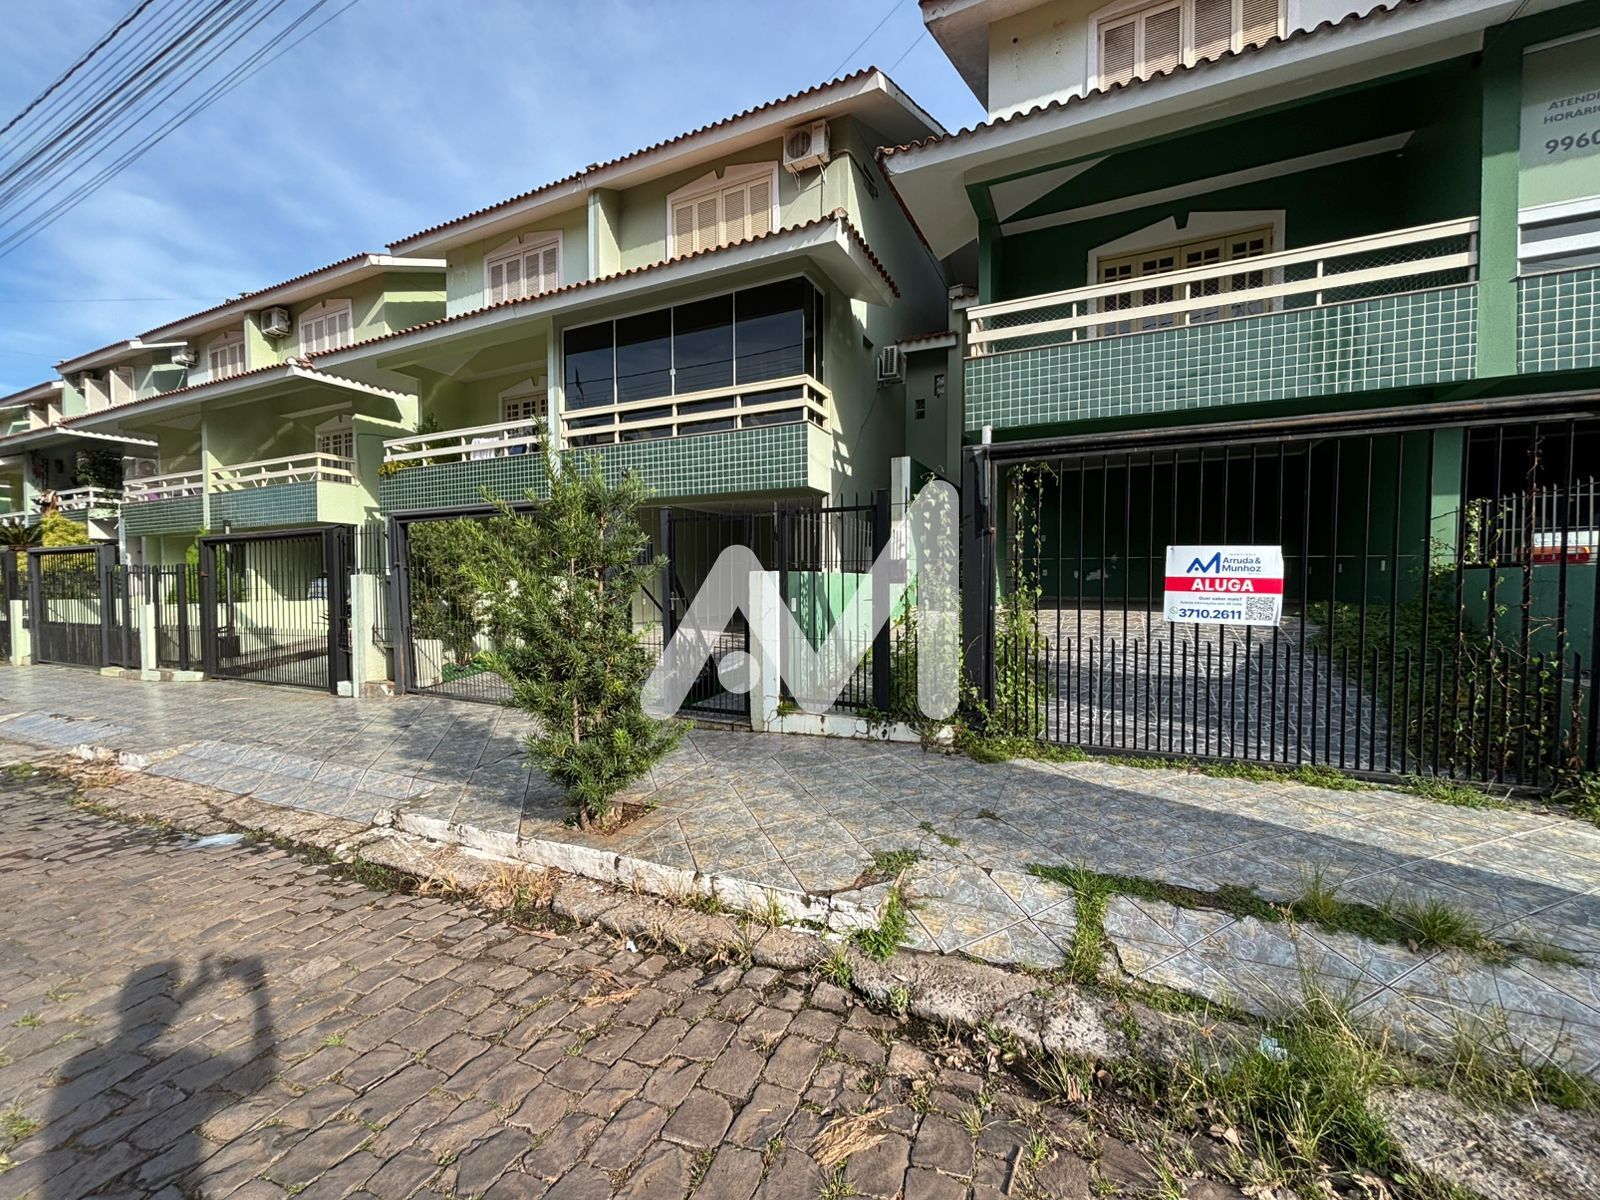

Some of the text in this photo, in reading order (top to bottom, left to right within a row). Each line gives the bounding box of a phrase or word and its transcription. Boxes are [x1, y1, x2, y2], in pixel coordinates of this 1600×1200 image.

[1221, 564, 1262, 573] Munhoz
[1190, 578, 1255, 592] ALUGA
[1178, 608, 1242, 620] 3710.2611
